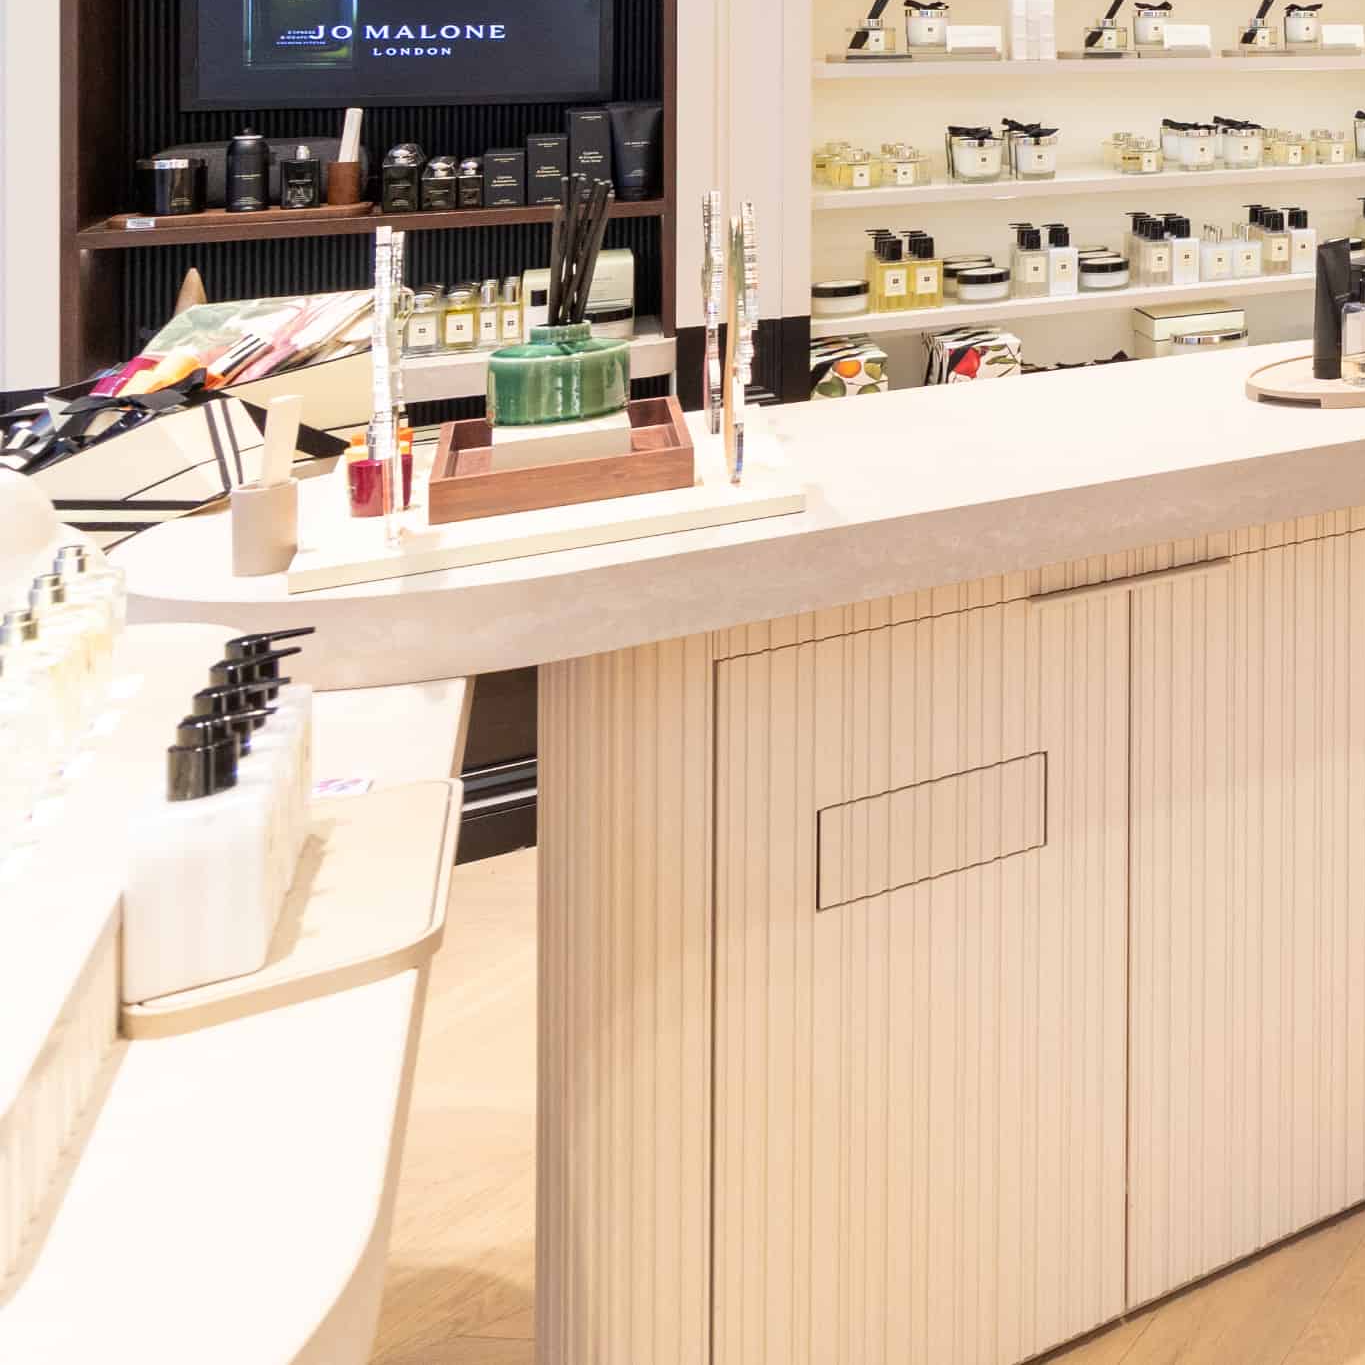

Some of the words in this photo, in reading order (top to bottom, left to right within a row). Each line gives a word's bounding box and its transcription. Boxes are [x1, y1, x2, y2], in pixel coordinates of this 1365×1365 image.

[308, 25, 353, 40] JO
[365, 24, 506, 40] MALONE
[373, 47, 452, 56] LONDON
